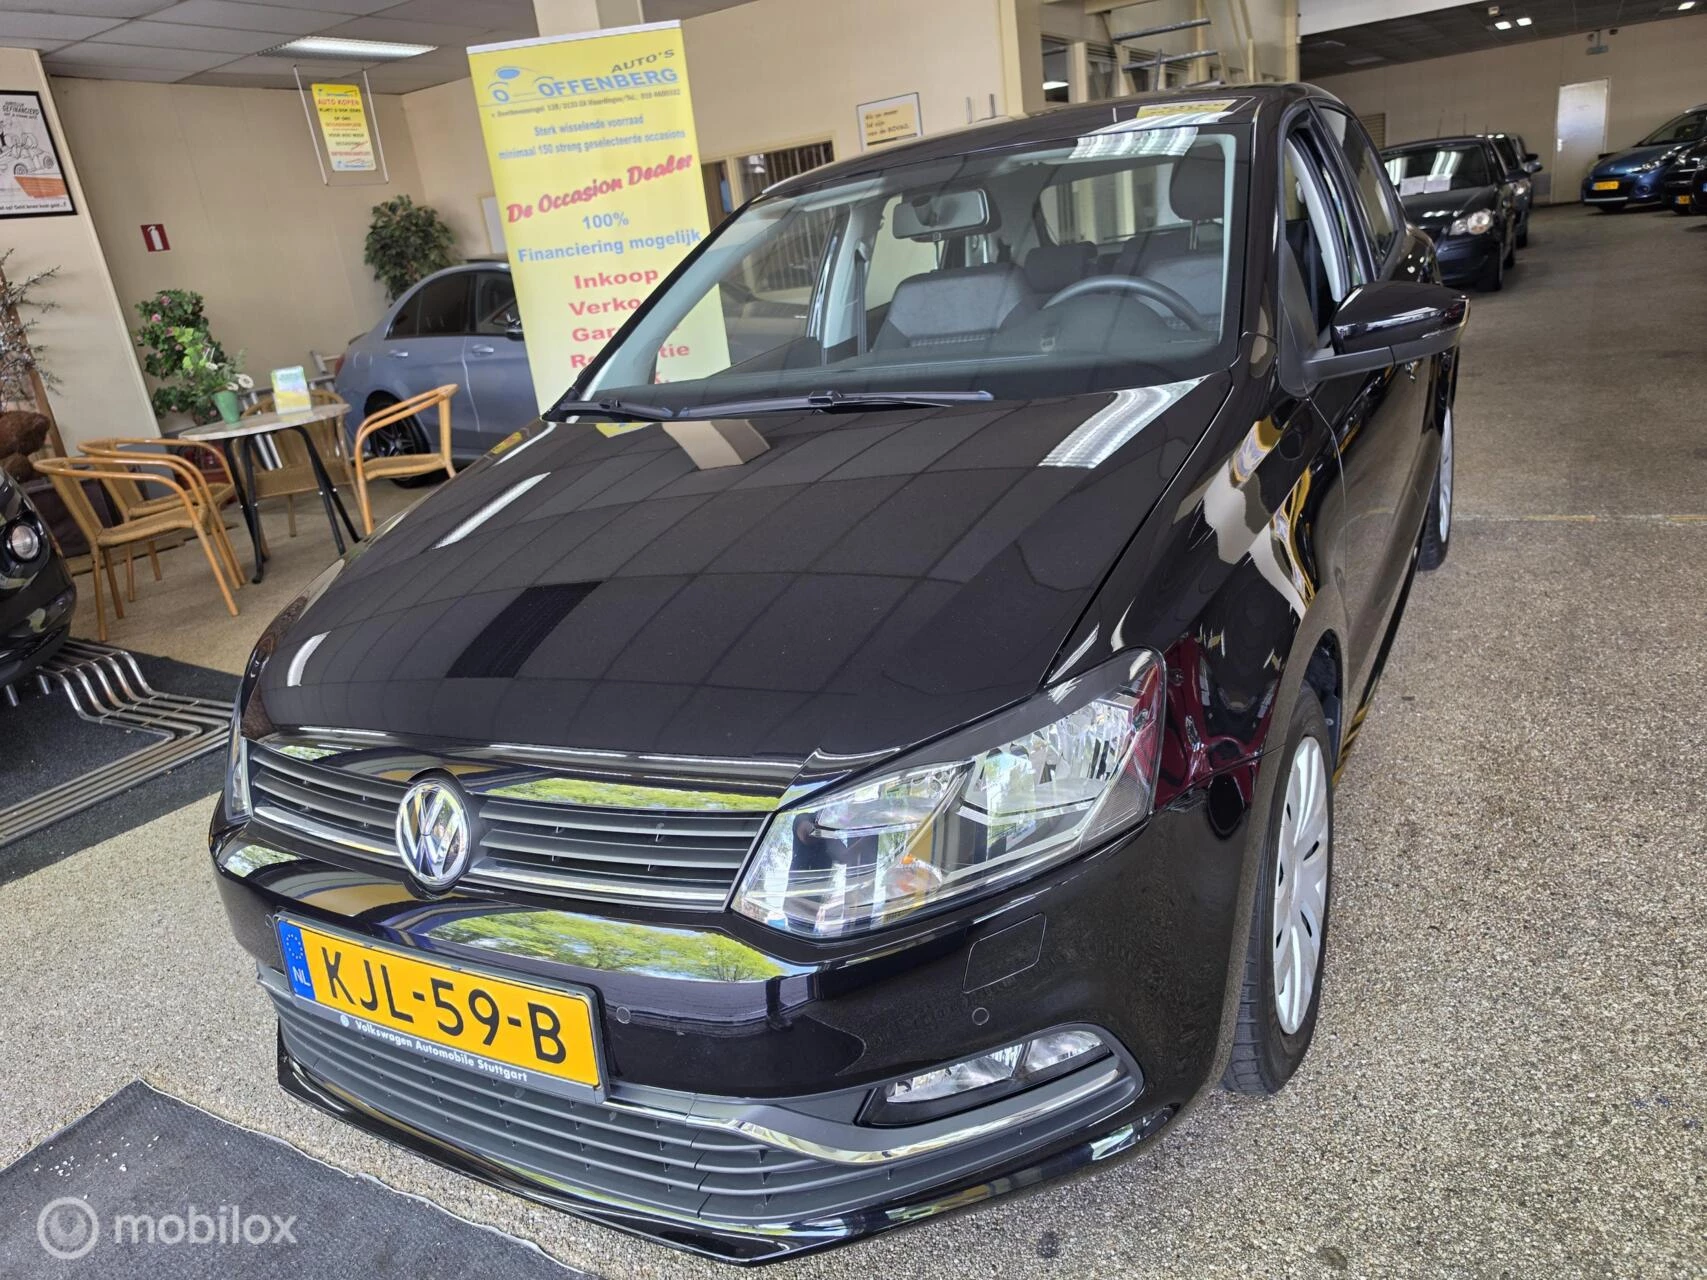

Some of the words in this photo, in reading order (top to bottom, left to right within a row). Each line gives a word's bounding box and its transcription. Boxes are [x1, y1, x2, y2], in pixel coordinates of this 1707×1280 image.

[611, 49, 675, 73] AUTO'S
[538, 68, 678, 98] OFFENBERG
[534, 125, 557, 137] Sterk
[559, 120, 605, 134] wisselende
[607, 115, 644, 130] voorraad
[498, 146, 536, 160] minimaal
[555, 141, 582, 155] streng
[584, 135, 642, 152] geselecteerde
[644, 130, 686, 143] occasions
[506, 203, 533, 223] De
[538, 176, 623, 213] Occasion
[627, 154, 693, 185] Dealer
[582, 211, 629, 230] 100%
[517, 240, 624, 263] Financiering
[629, 229, 701, 251] mogelijk
[574, 268, 658, 290] Inkoop
[568, 297, 641, 317] Verko
[292, 966, 311, 987] NL
[321, 947, 566, 1064] KJL-59-B
[355, 1020, 412, 1048] Volkswagen
[415, 1040, 475, 1067] Automobile
[478, 1059, 527, 1082] Stuttgart
